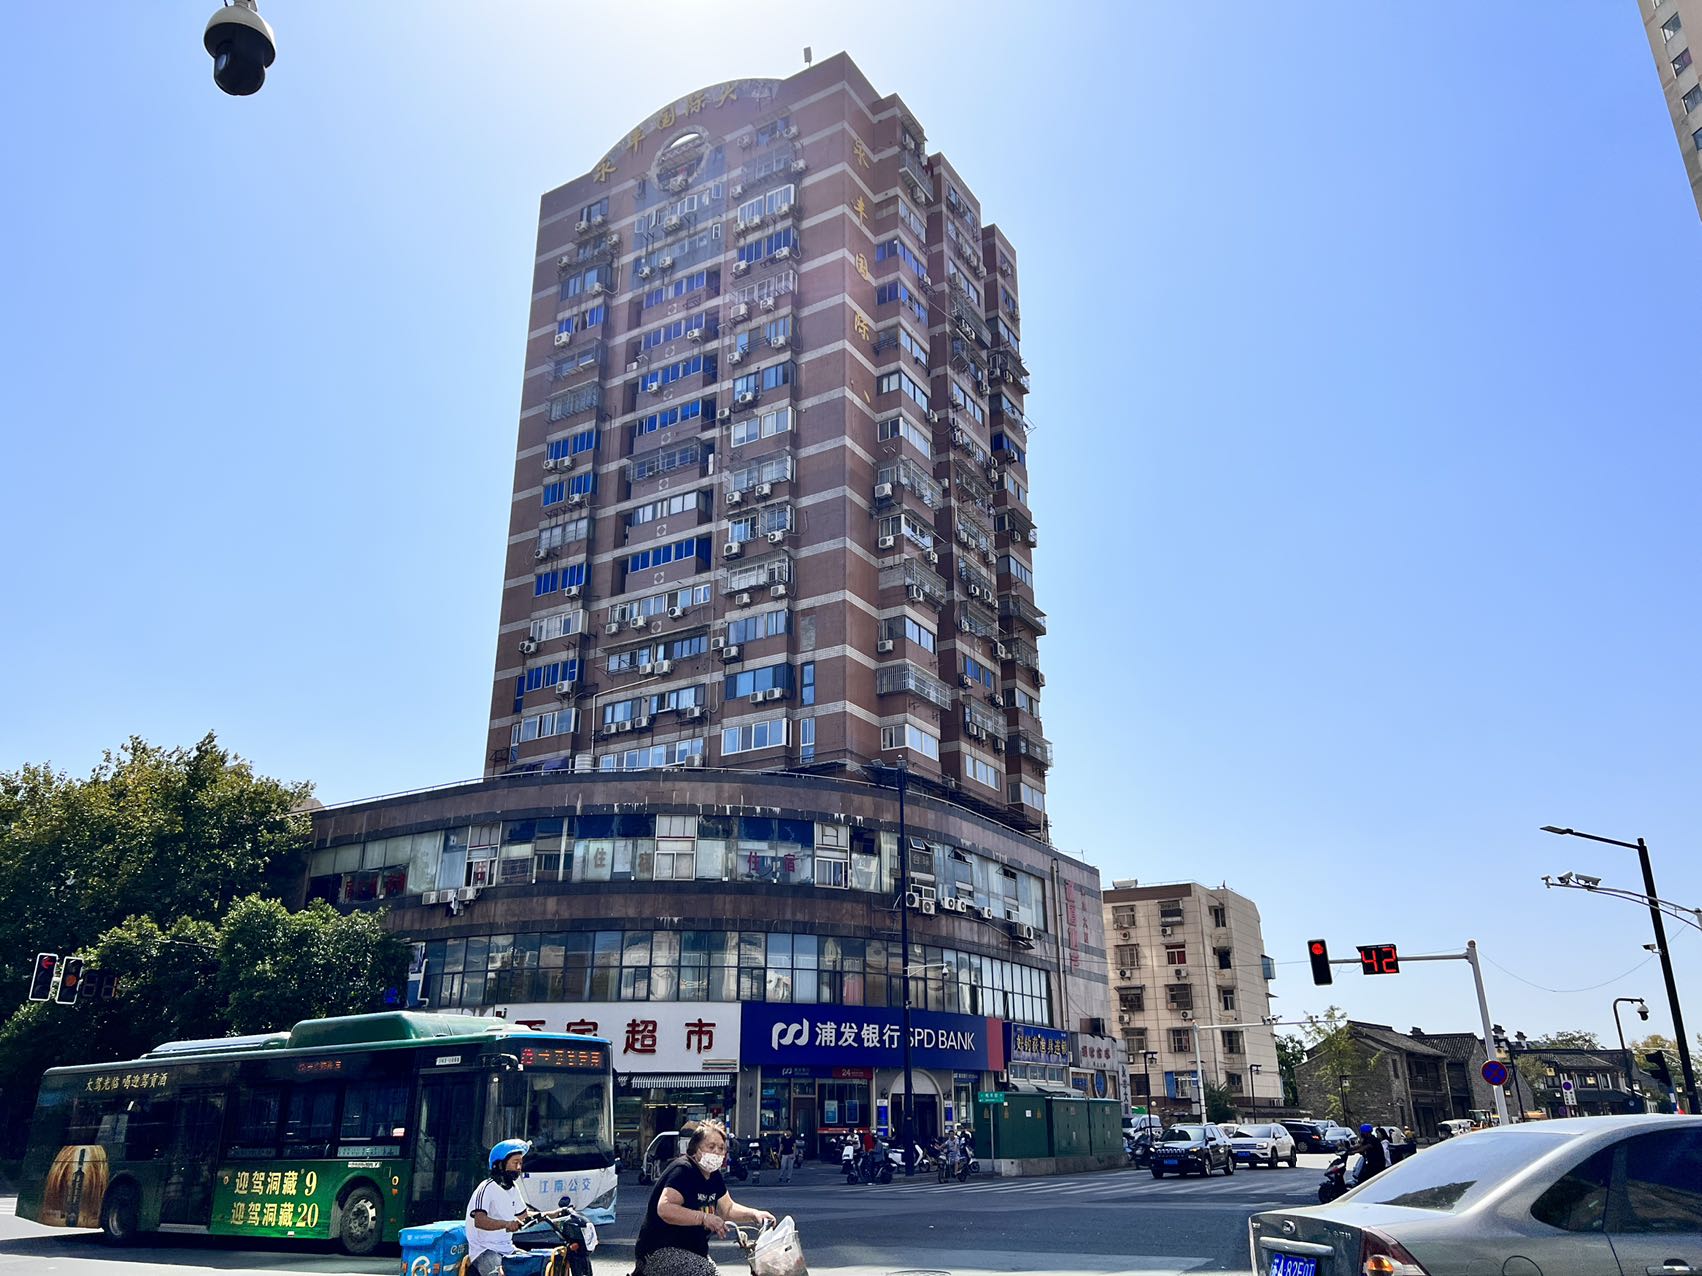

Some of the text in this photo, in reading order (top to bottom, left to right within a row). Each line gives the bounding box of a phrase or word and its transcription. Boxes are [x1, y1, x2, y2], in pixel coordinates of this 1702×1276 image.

[747, 851, 797, 873] 住宿
[1361, 947, 1397, 973] 42
[816, 1022, 976, 1051] 浦发银行 SPD BANK
[841, 1068, 851, 1077] 24
[85, 1076, 120, 1092] 大驾光临
[539, 1177, 592, 1194] 江南公交
